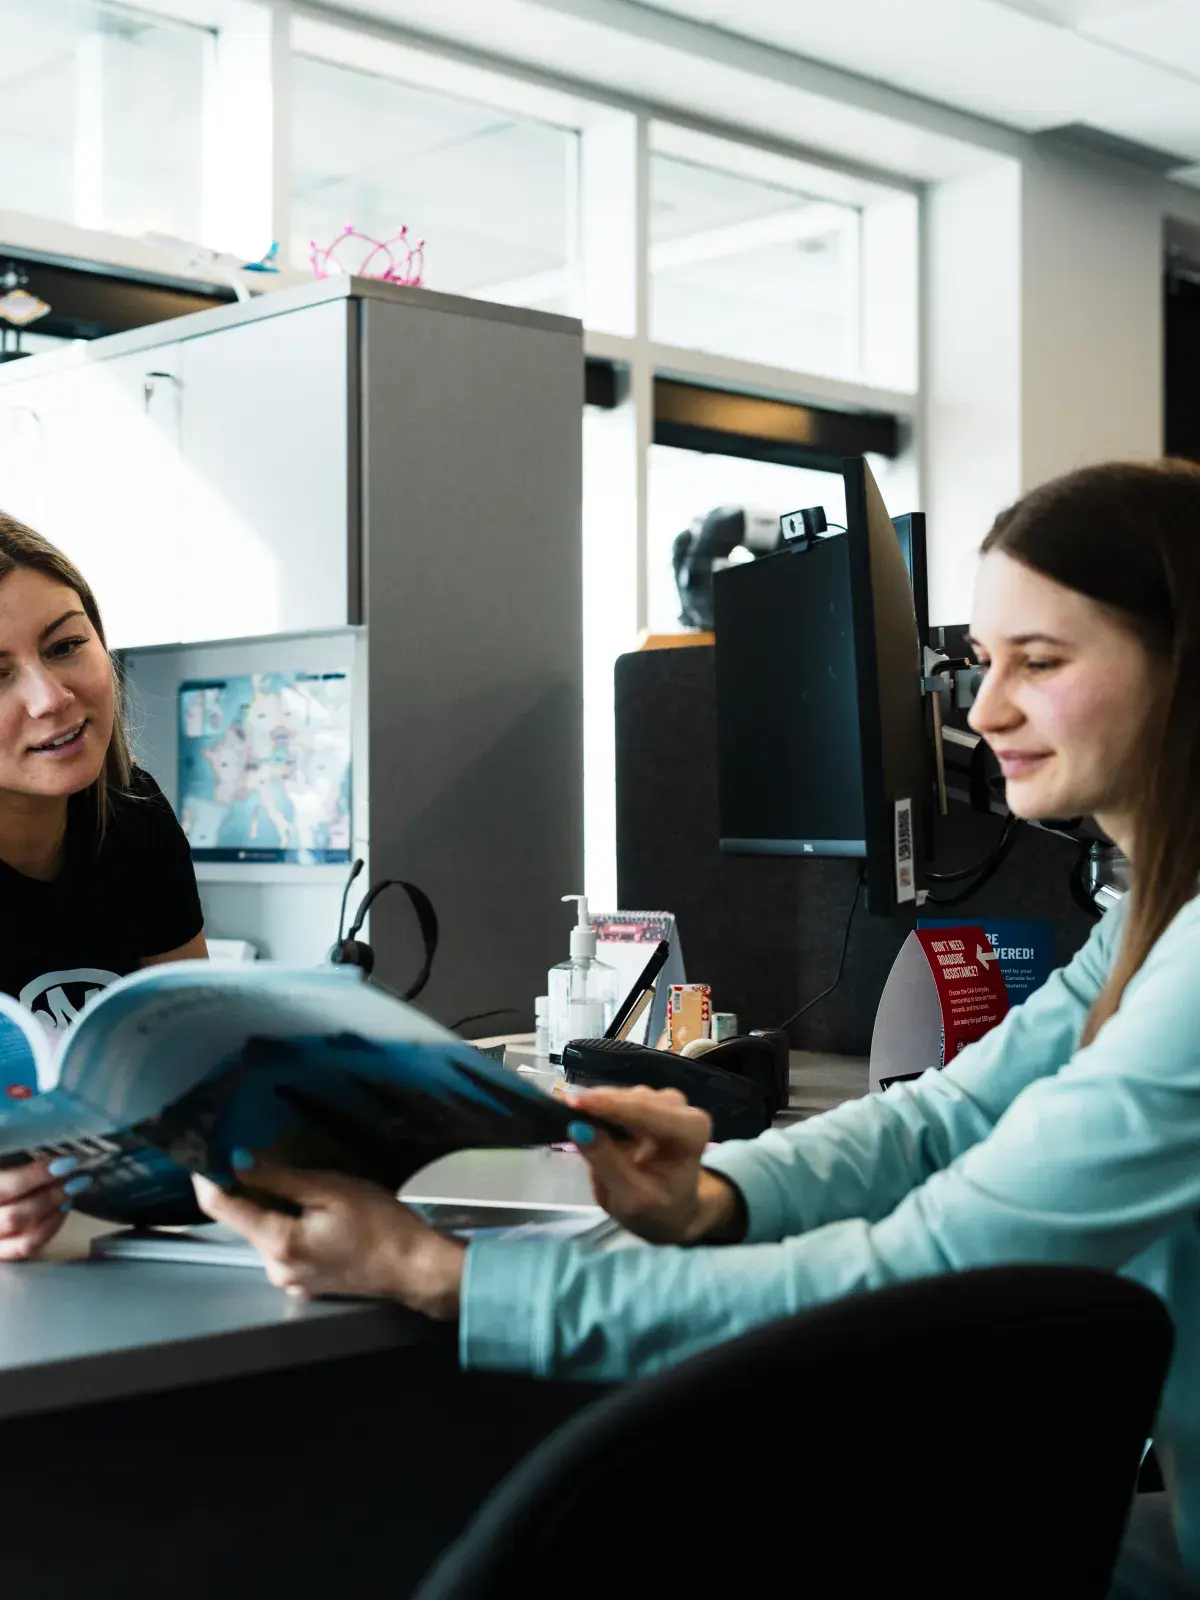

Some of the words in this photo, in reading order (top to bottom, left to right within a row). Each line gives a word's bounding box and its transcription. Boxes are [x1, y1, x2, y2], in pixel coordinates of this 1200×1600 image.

[931, 940, 950, 953] DON'T
[948, 939, 966, 951] NEED
[937, 953, 967, 966] ROADSIDE
[993, 947, 1035, 960] VERED!
[942, 965, 979, 980] ASSISTANCE?
